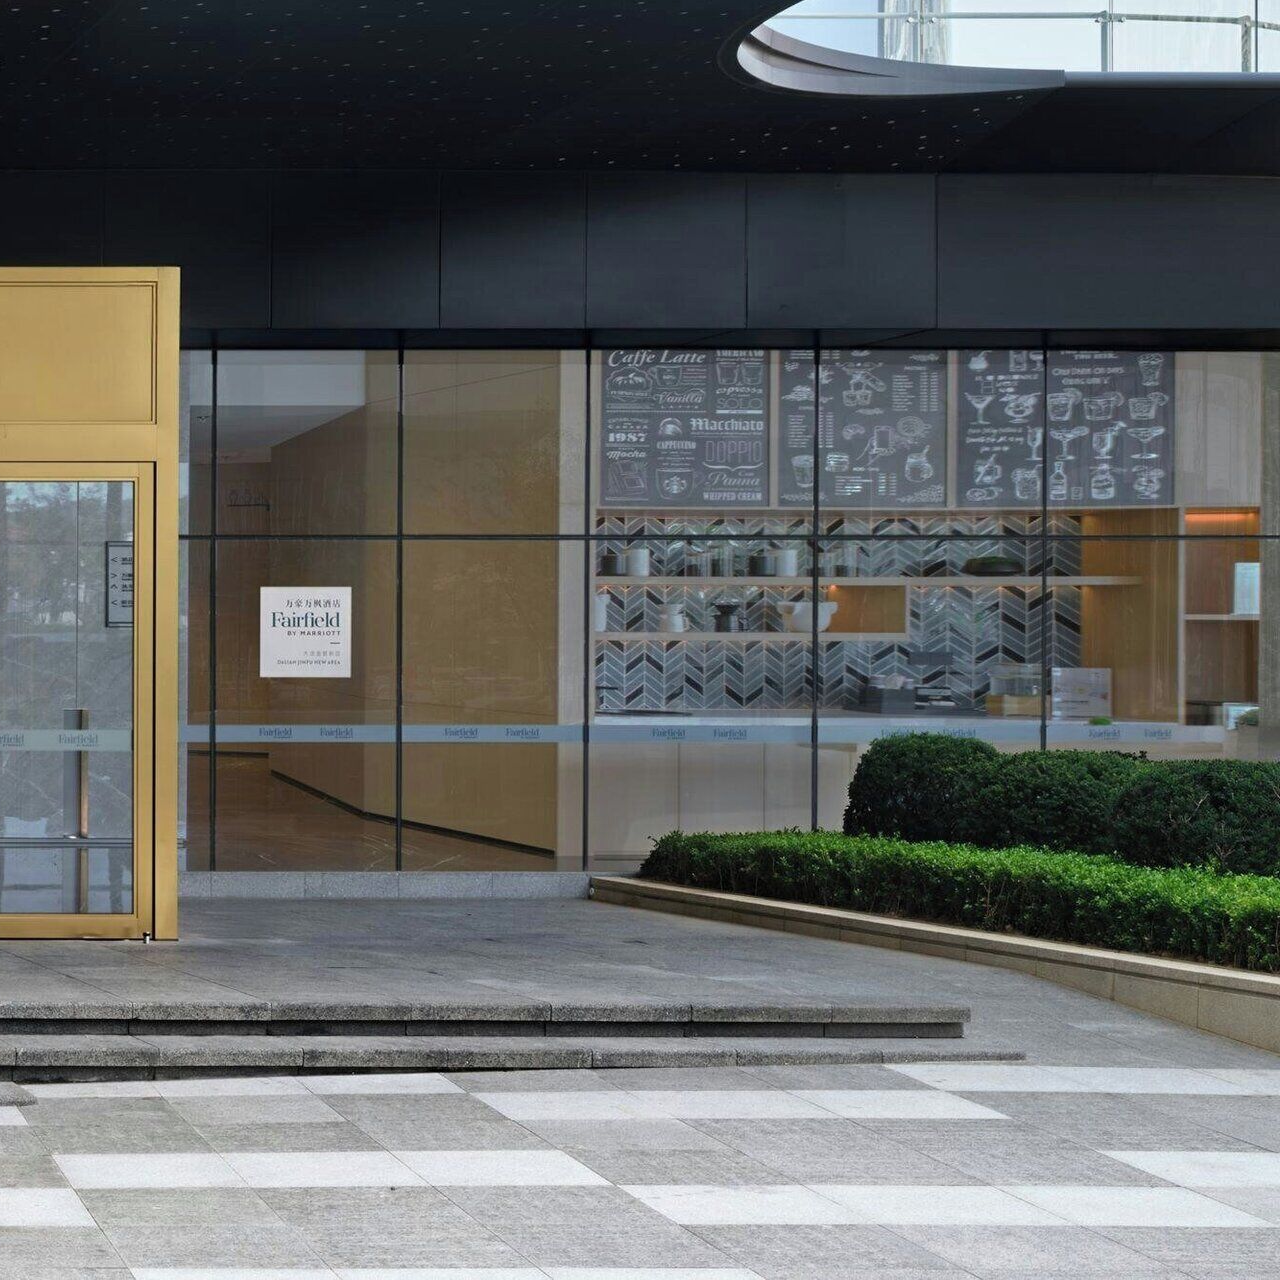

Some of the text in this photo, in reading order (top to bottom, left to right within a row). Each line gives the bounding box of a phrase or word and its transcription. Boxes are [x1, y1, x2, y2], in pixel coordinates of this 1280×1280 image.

[660, 349, 706, 363] Latte
[690, 418, 764, 431] Macchiato
[608, 432, 646, 442] 1987
[705, 440, 762, 463] DOPPIO
[271, 611, 340, 628] Fairfield
